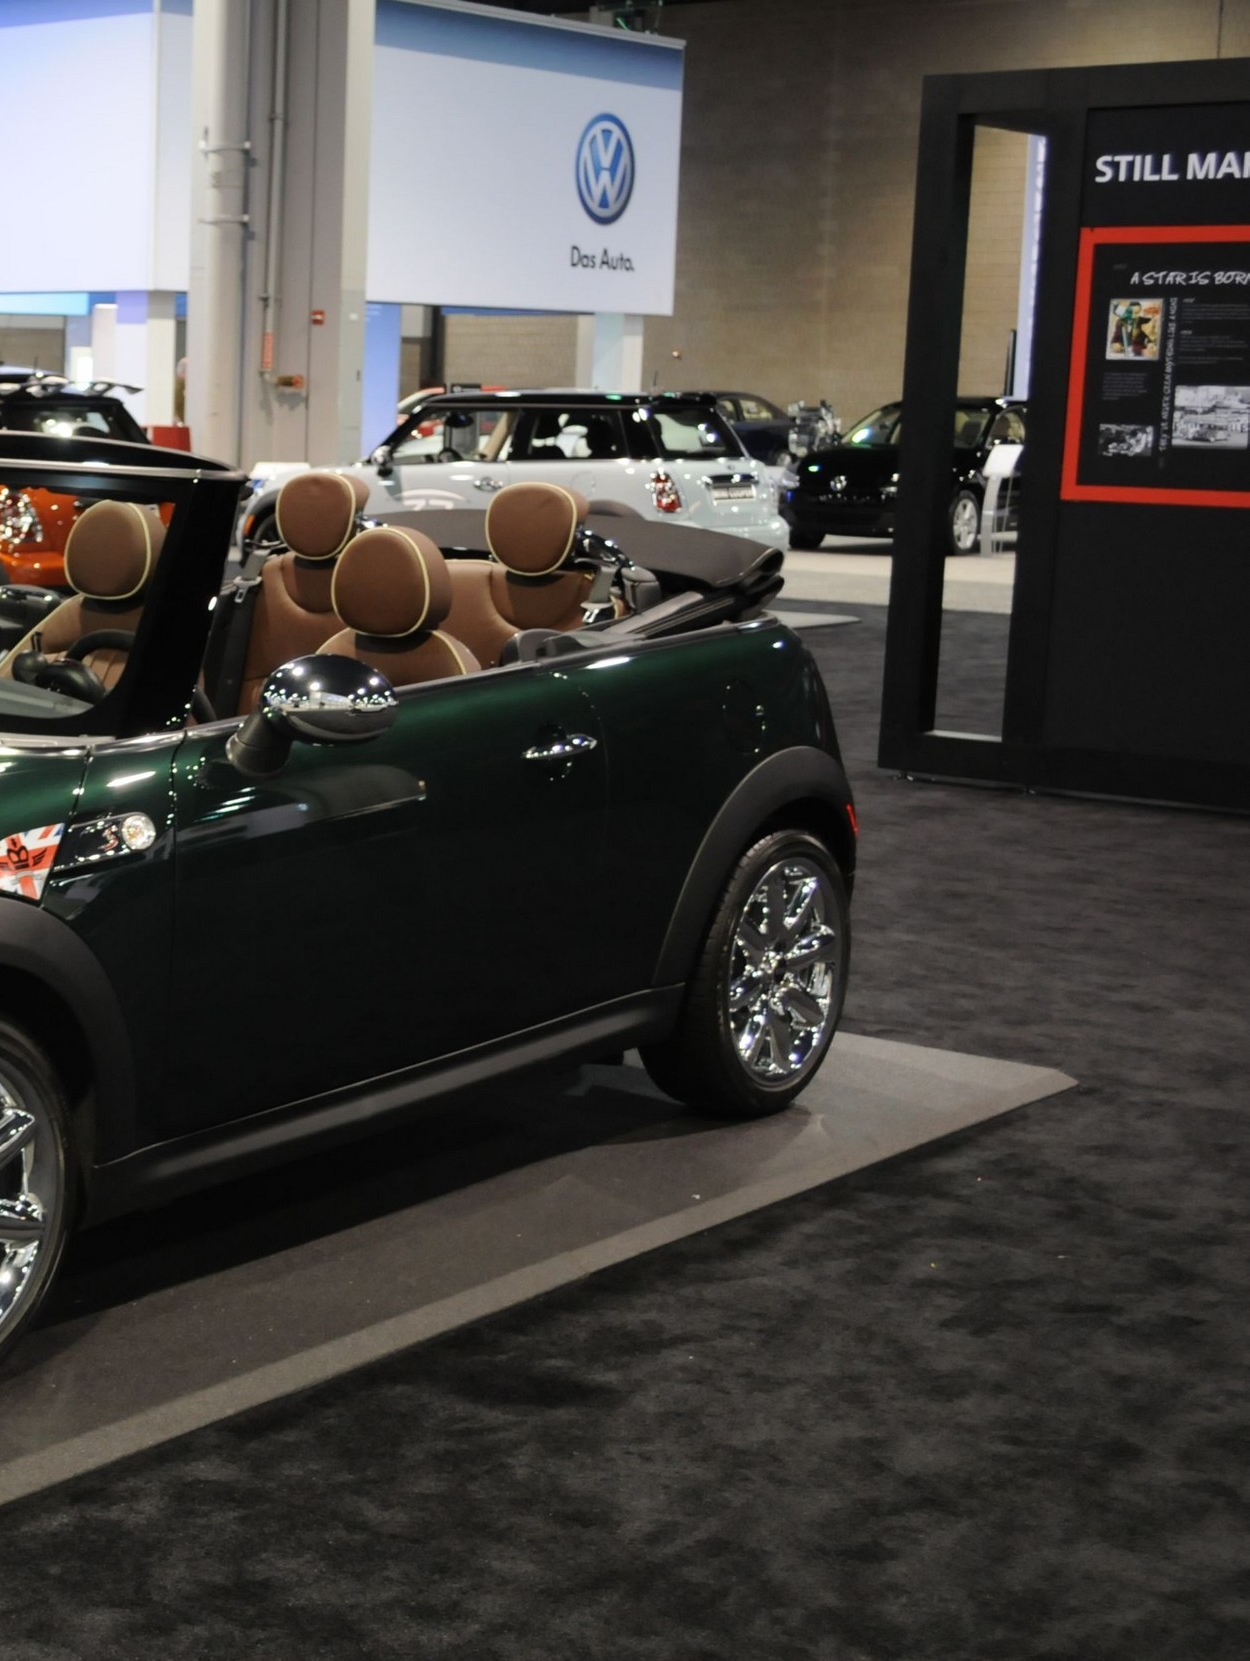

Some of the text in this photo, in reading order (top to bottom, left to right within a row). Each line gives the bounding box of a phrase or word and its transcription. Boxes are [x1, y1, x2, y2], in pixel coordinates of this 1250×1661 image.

[1095, 151, 1250, 183] STILL MA
[570, 245, 635, 272] Das Auto.
[1142, 270, 1187, 287] STAR
[1188, 271, 1212, 286] IS
